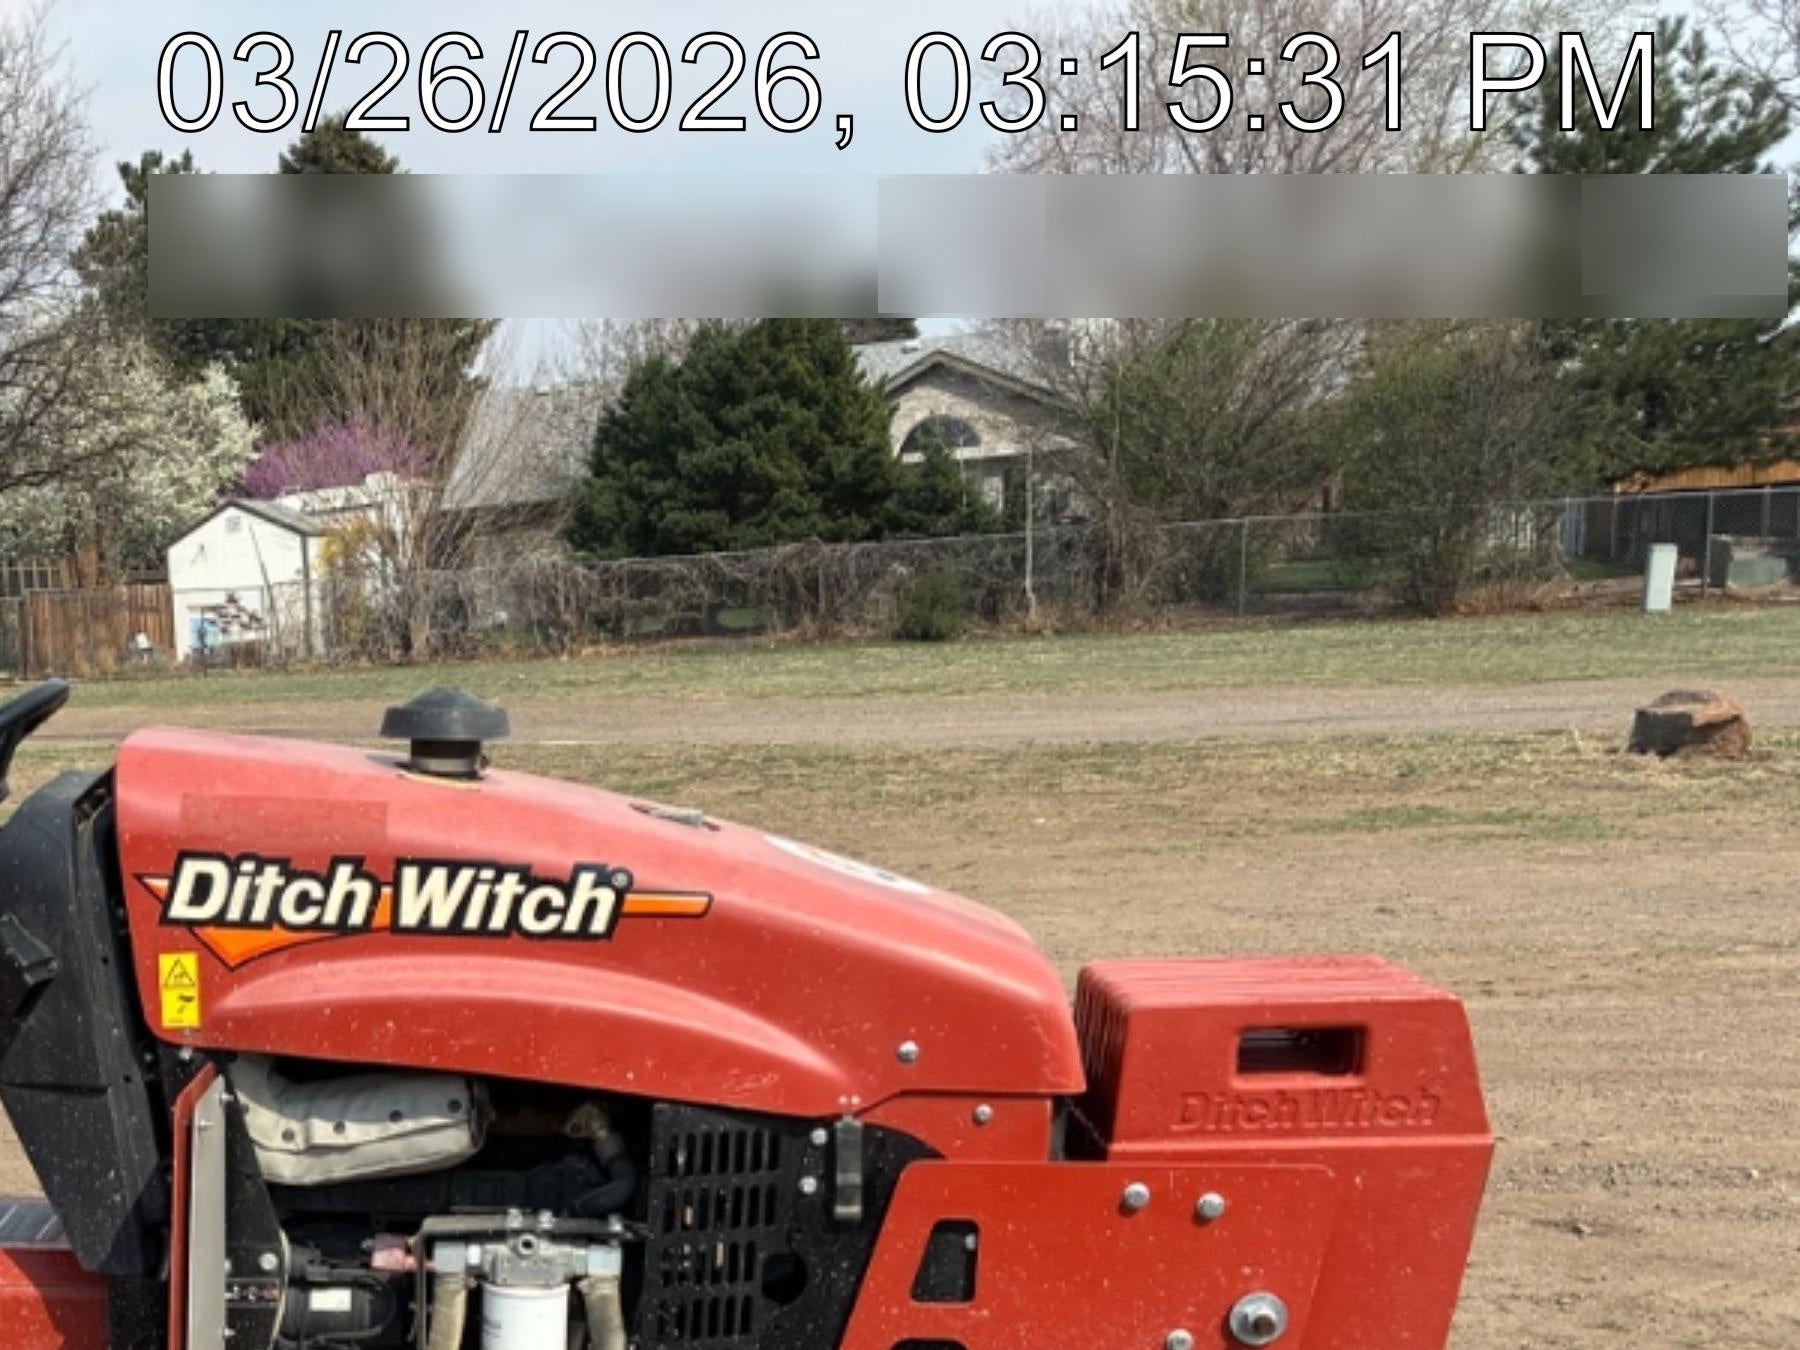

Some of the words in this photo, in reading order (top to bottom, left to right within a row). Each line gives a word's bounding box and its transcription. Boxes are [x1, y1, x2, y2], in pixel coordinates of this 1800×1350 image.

[166, 858, 374, 926] Ditch
[397, 865, 618, 935] Witch
[1170, 1090, 1298, 1132] Ditch
[1300, 1086, 1442, 1129] Witch
